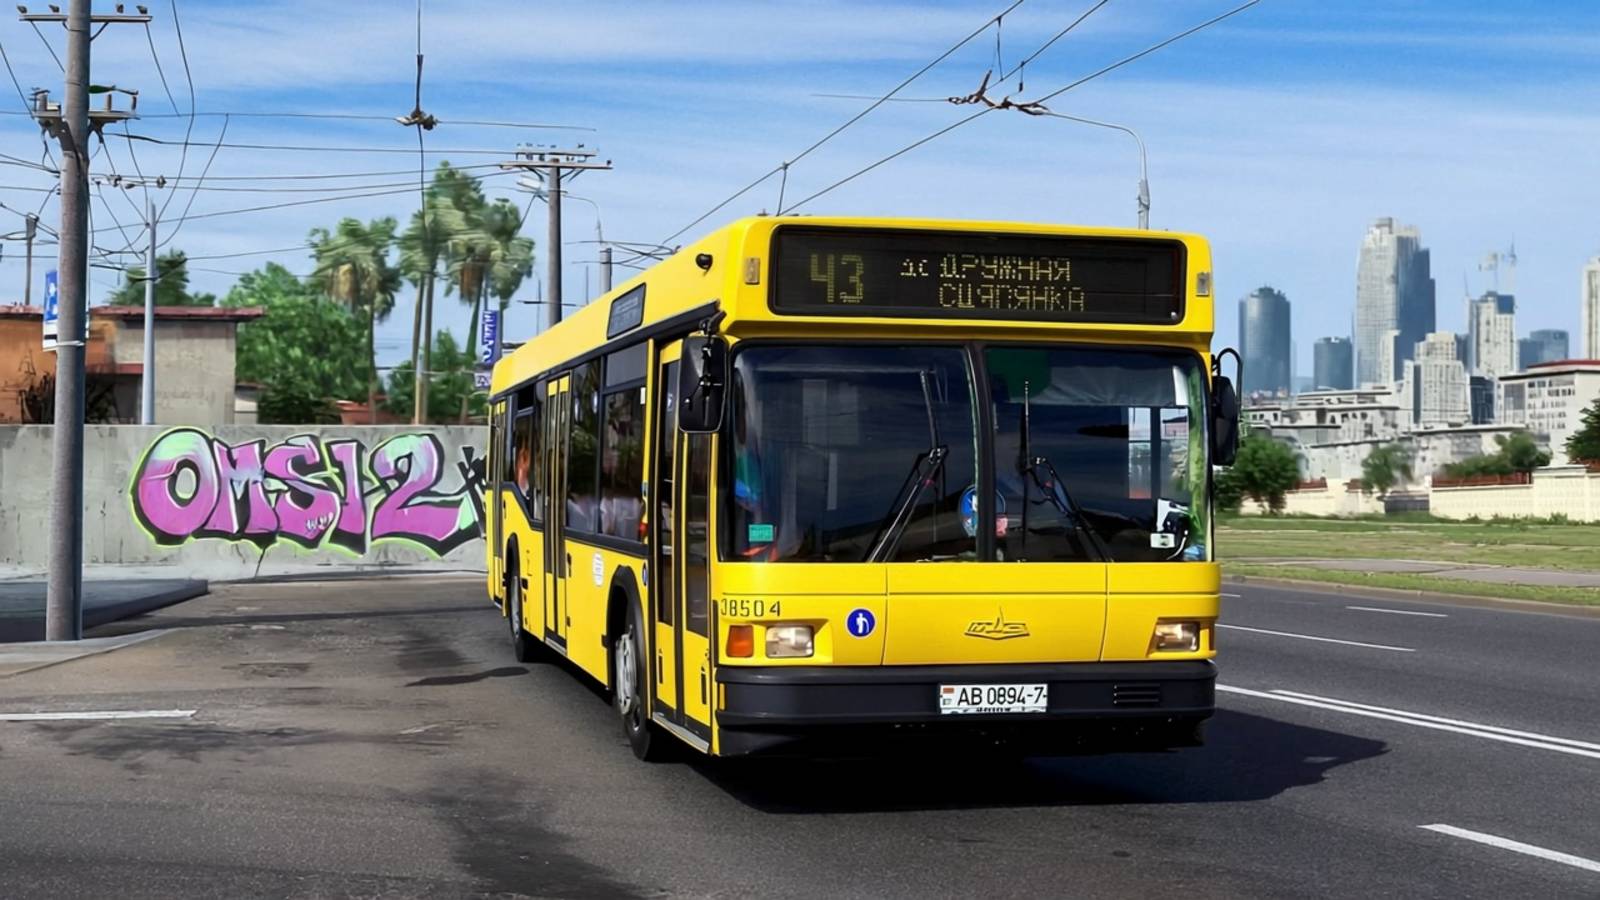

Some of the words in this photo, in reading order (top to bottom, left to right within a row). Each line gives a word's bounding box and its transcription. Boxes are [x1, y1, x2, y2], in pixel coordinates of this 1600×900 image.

[809, 253, 864, 304] 43
[957, 687, 983, 706] AB
[987, 686, 1045, 705] 0894-7
